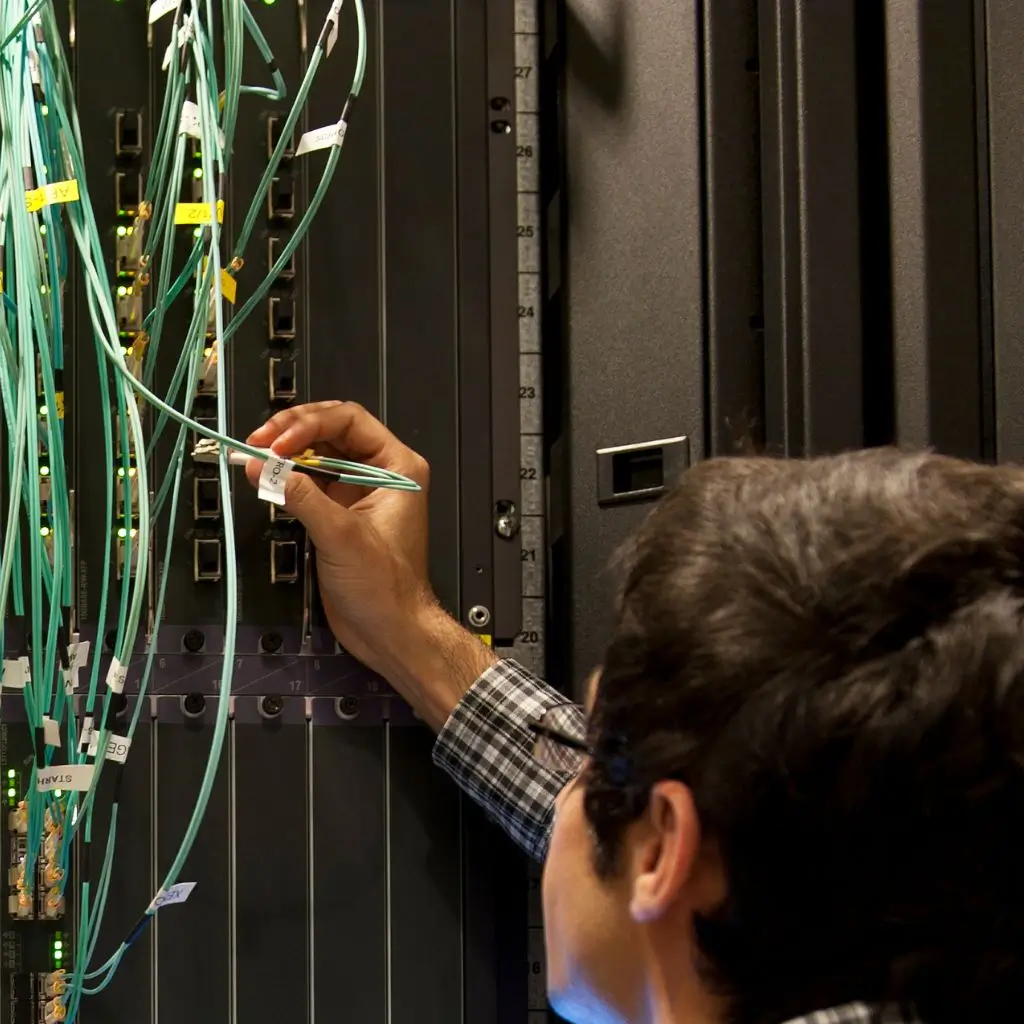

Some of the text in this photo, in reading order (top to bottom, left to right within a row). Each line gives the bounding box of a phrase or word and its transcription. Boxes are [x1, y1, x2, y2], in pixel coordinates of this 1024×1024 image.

[515, 66, 532, 78] 27
[516, 147, 533, 158] 26
[517, 226, 534, 238] 25
[518, 306, 534, 318] 24
[519, 387, 535, 398] 23
[520, 467, 536, 480] 22
[521, 549, 536, 561] 21
[521, 630, 539, 643] 20
[159, 658, 166, 669] 6
[237, 659, 243, 669] 7
[289, 680, 302, 691] 17
